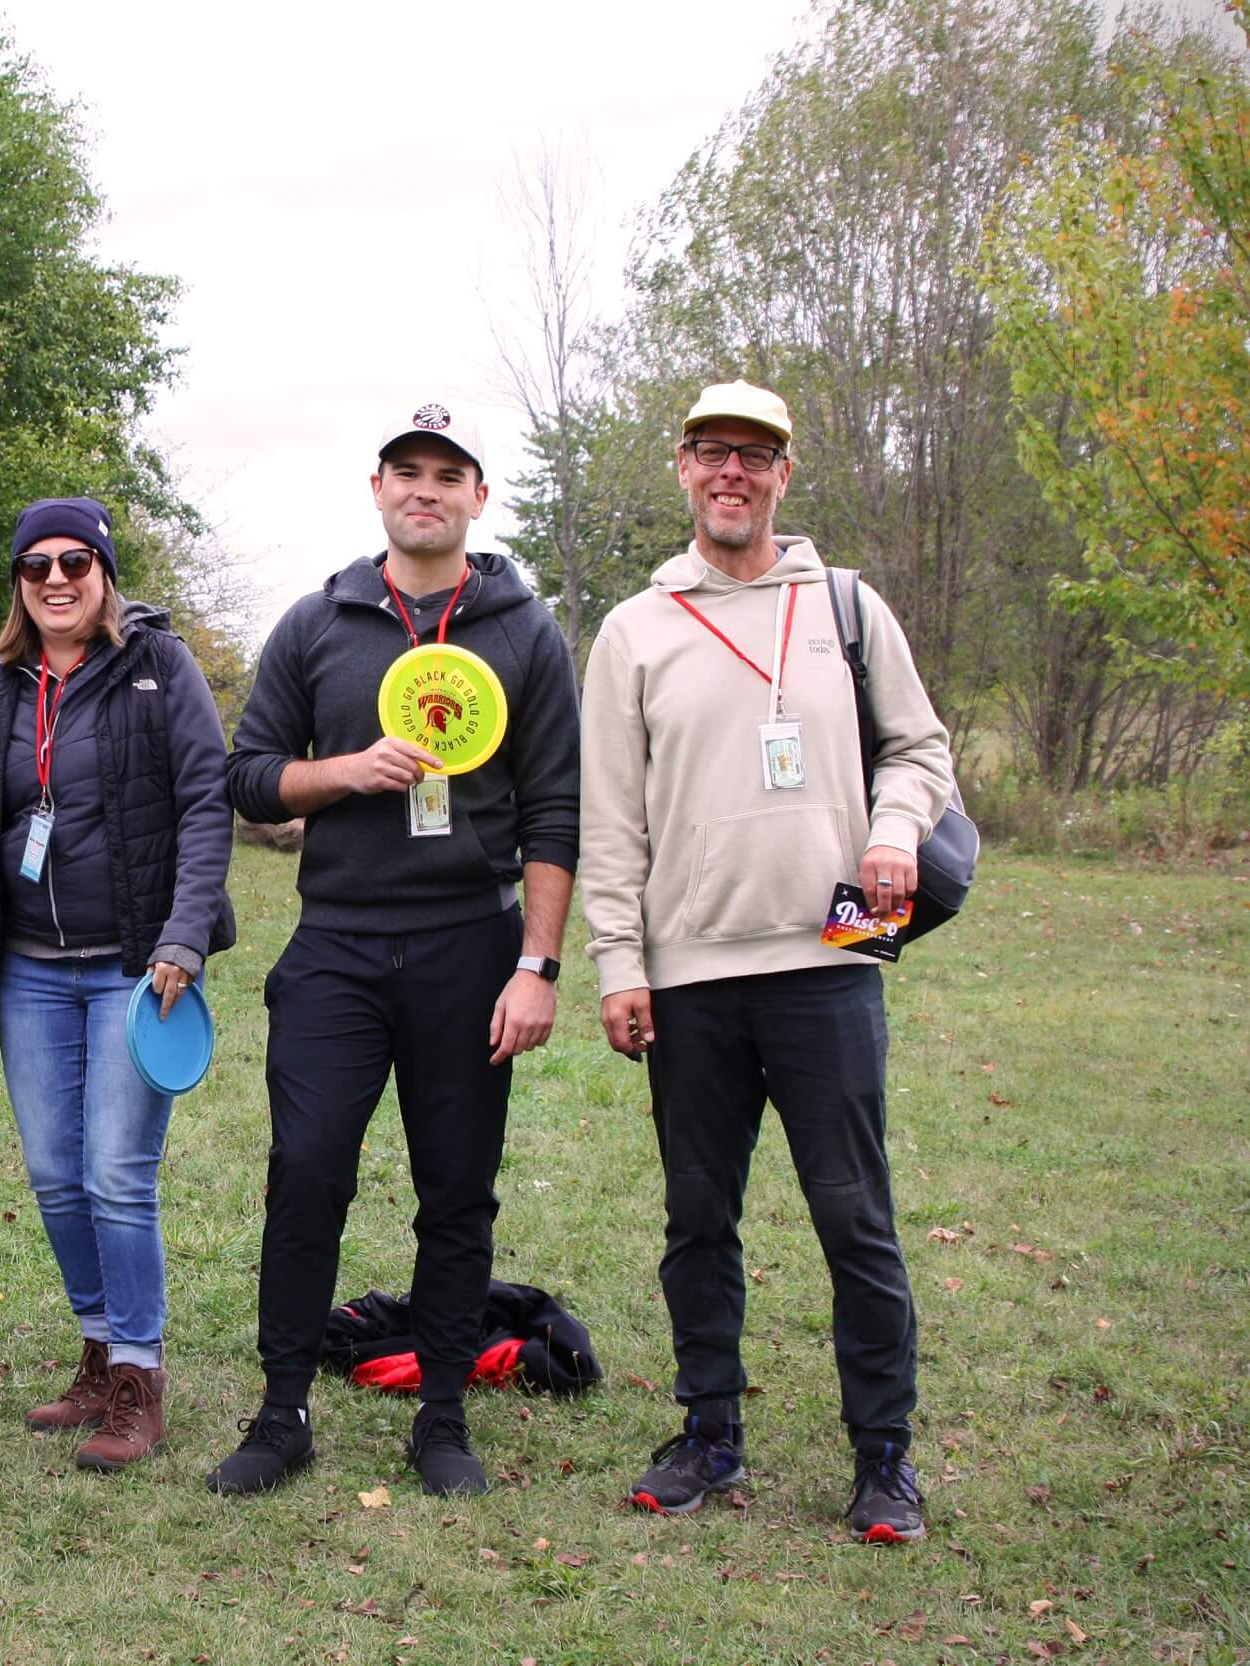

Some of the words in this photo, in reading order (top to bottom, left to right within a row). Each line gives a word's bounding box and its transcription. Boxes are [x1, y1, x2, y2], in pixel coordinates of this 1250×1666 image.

[809, 646, 830, 655] today
[413, 670, 446, 688] BLACK
[450, 675, 464, 689] GO
[403, 686, 415, 701] GO
[417, 694, 463, 721] WARRIORS
[463, 688, 480, 716] GOLD
[401, 705, 416, 733] GOLD
[465, 720, 478, 735] GO
[415, 733, 430, 747] GO
[434, 734, 468, 751] BLACK
